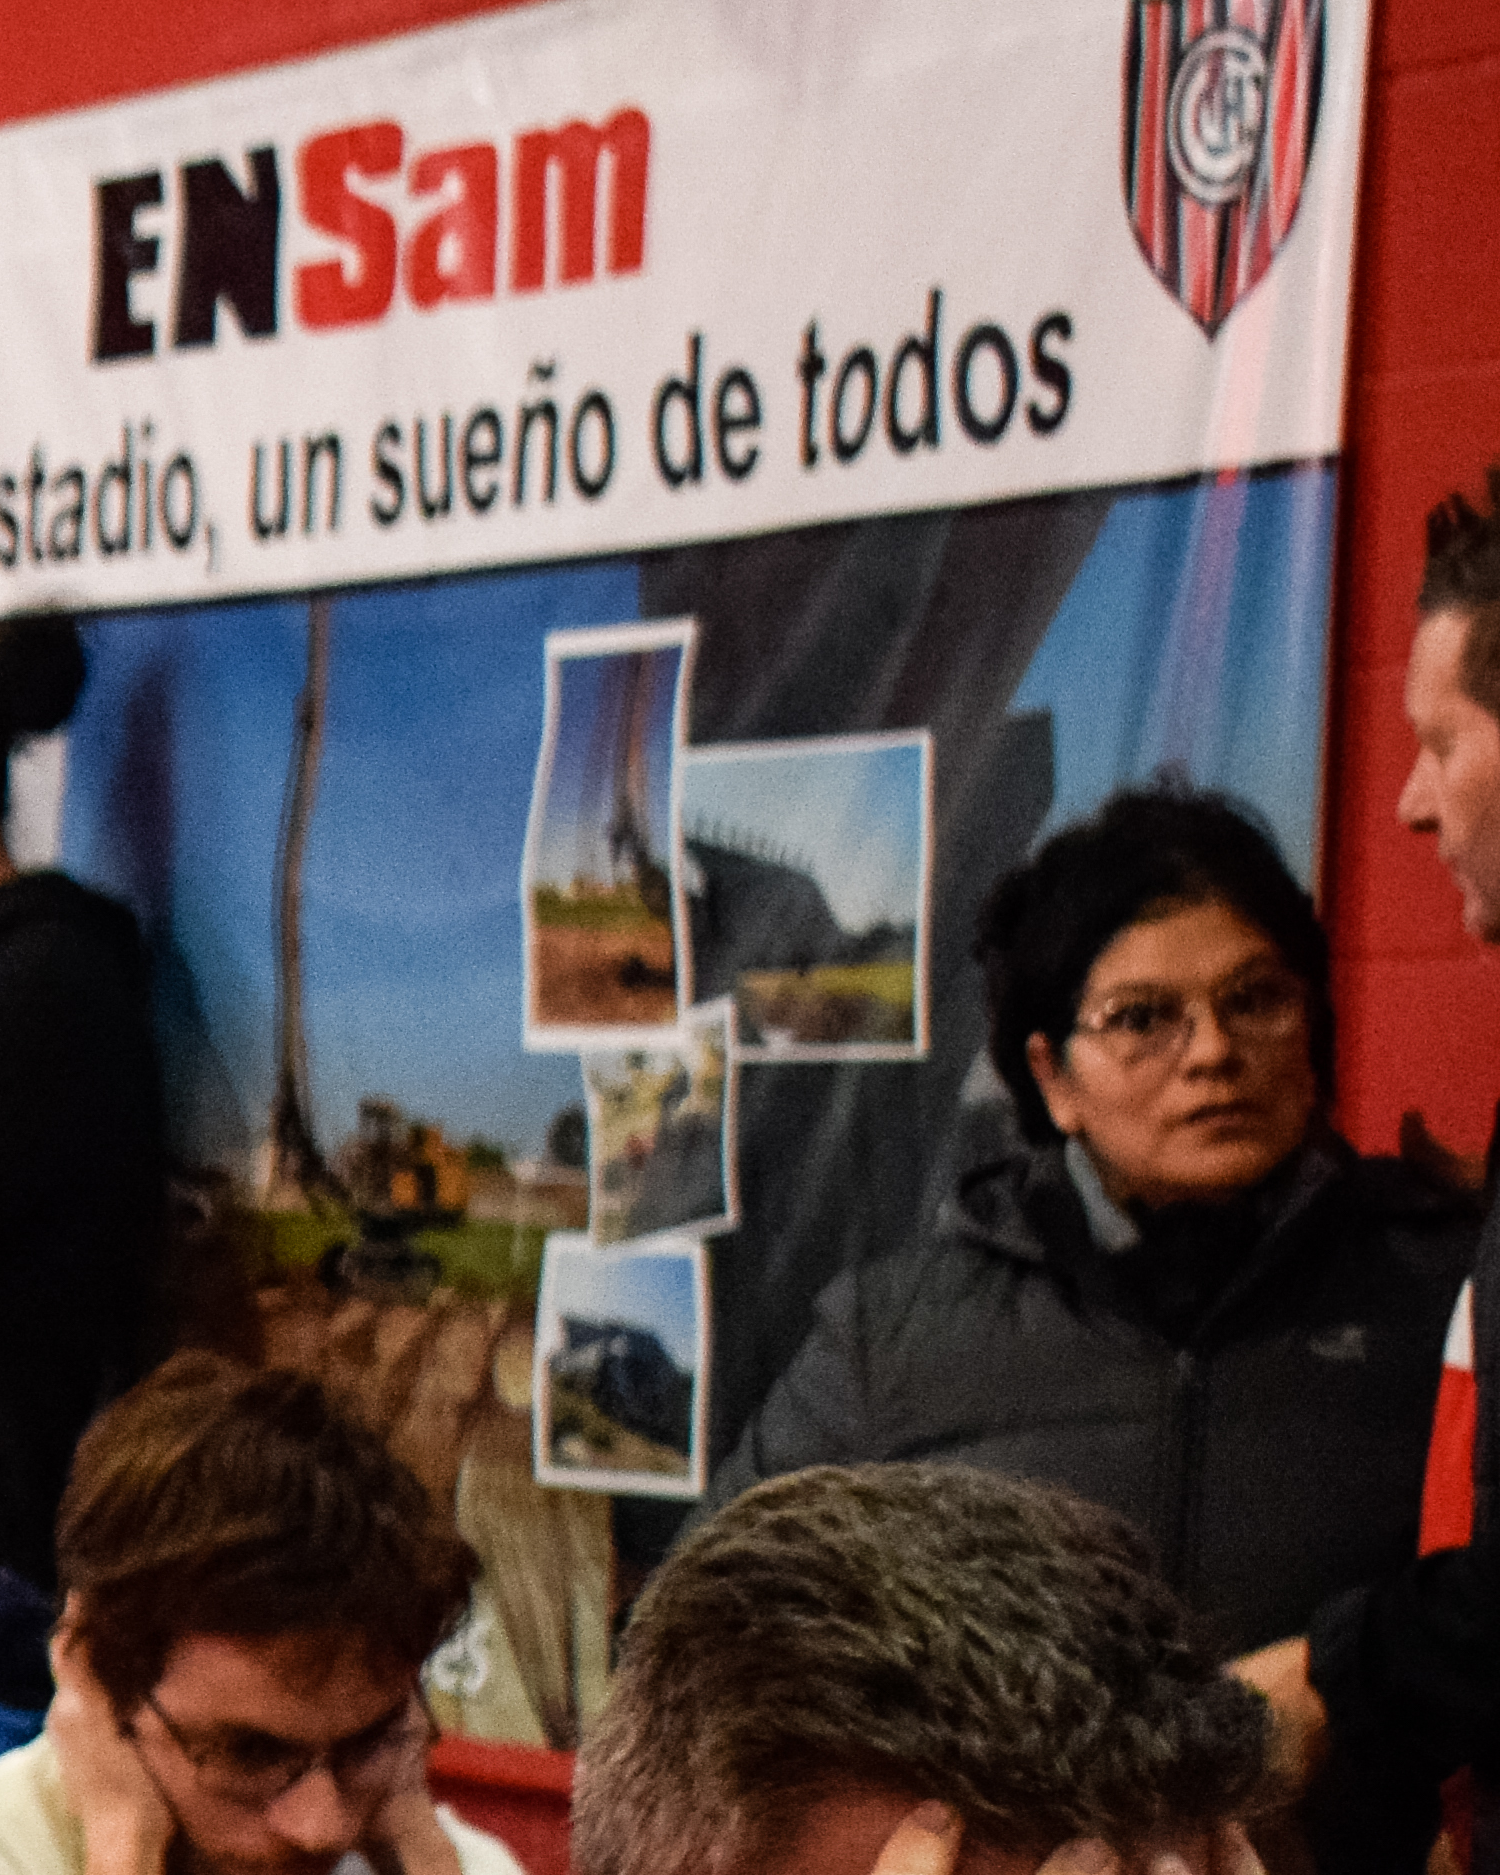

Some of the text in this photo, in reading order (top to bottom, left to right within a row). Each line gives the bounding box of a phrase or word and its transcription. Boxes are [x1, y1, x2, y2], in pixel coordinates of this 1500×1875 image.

[90, 107, 650, 366] ENSam
[247, 429, 343, 546] un
[369, 361, 617, 526] sueño
[649, 330, 763, 490] de
[798, 286, 1075, 470] todos
